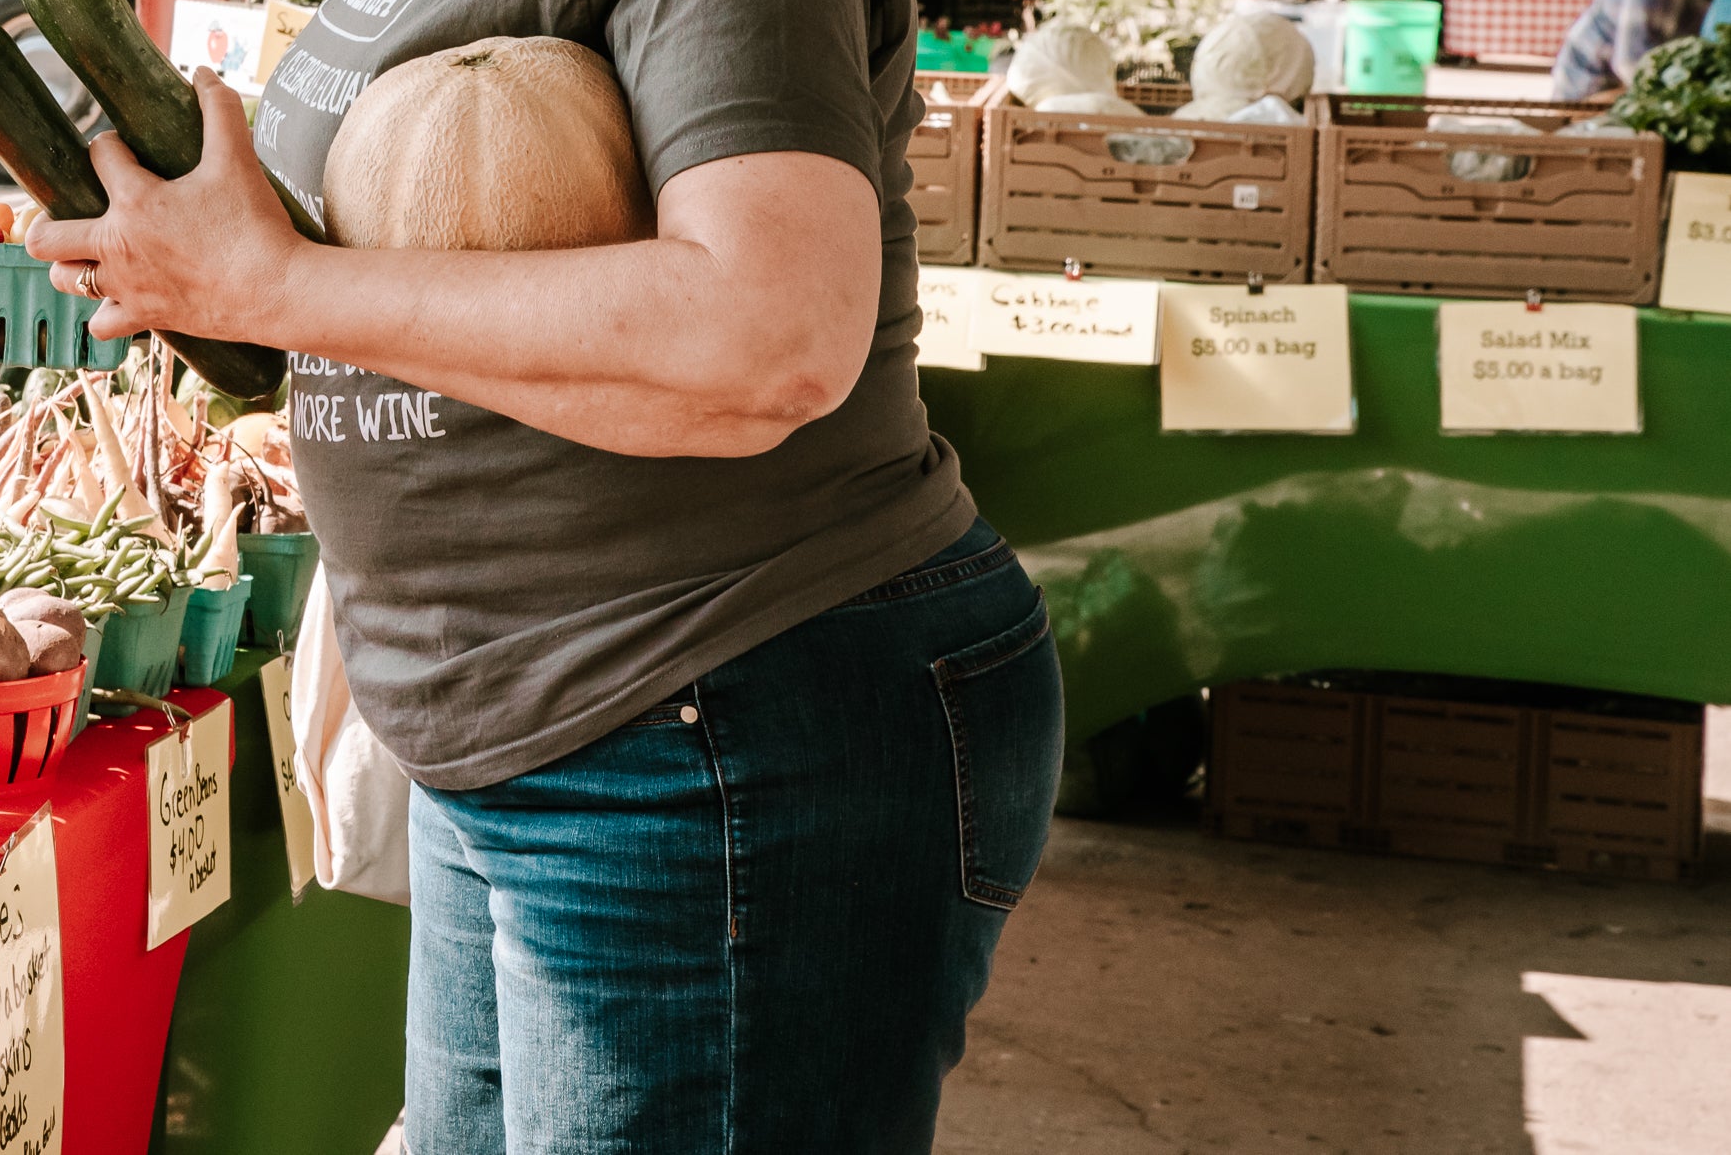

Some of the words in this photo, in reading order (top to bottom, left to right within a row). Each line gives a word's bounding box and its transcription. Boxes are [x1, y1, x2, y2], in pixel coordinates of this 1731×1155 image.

[991, 284, 1101, 314] Cabbage
[1209, 305, 1297, 327] Spinach
[1191, 337, 1250, 357] $5.00
[1255, 341, 1268, 355] a
[1274, 338, 1317, 360] bag
[1480, 330, 1542, 348] Salad
[1549, 332, 1592, 349] Mix
[1473, 359, 1535, 380] $5.00
[1540, 367, 1552, 379] a
[1558, 362, 1603, 386] bag
[294, 390, 346, 443] MORE
[355, 391, 447, 443] WINE
[159, 771, 196, 826] Green
[170, 815, 205, 877] $4.00
[12, 932, 52, 1009] basket
